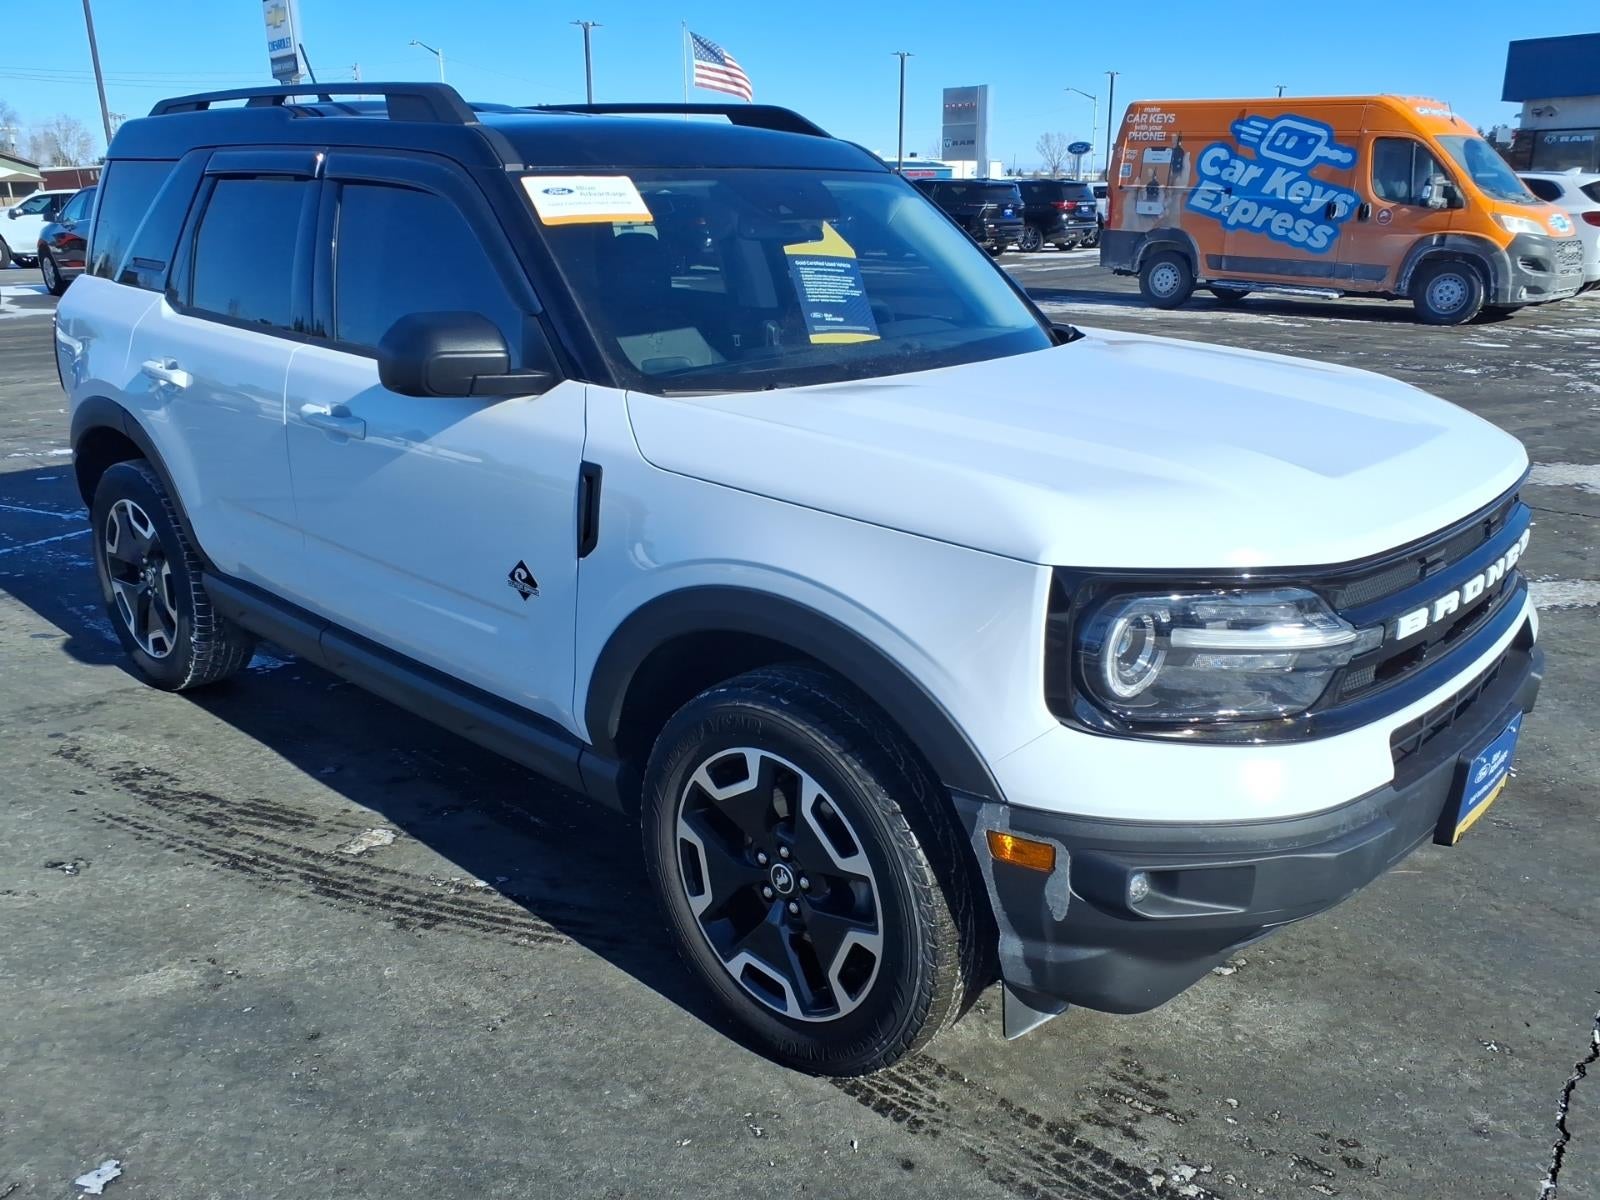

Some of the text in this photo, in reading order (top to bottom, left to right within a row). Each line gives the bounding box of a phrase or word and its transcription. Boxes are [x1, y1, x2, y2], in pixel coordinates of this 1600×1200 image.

[1126, 113, 1176, 123] CAR KEYS
[1128, 132, 1166, 141] PHONE!
[1201, 147, 1355, 218] Car Keys
[1189, 179, 1334, 248] Express
